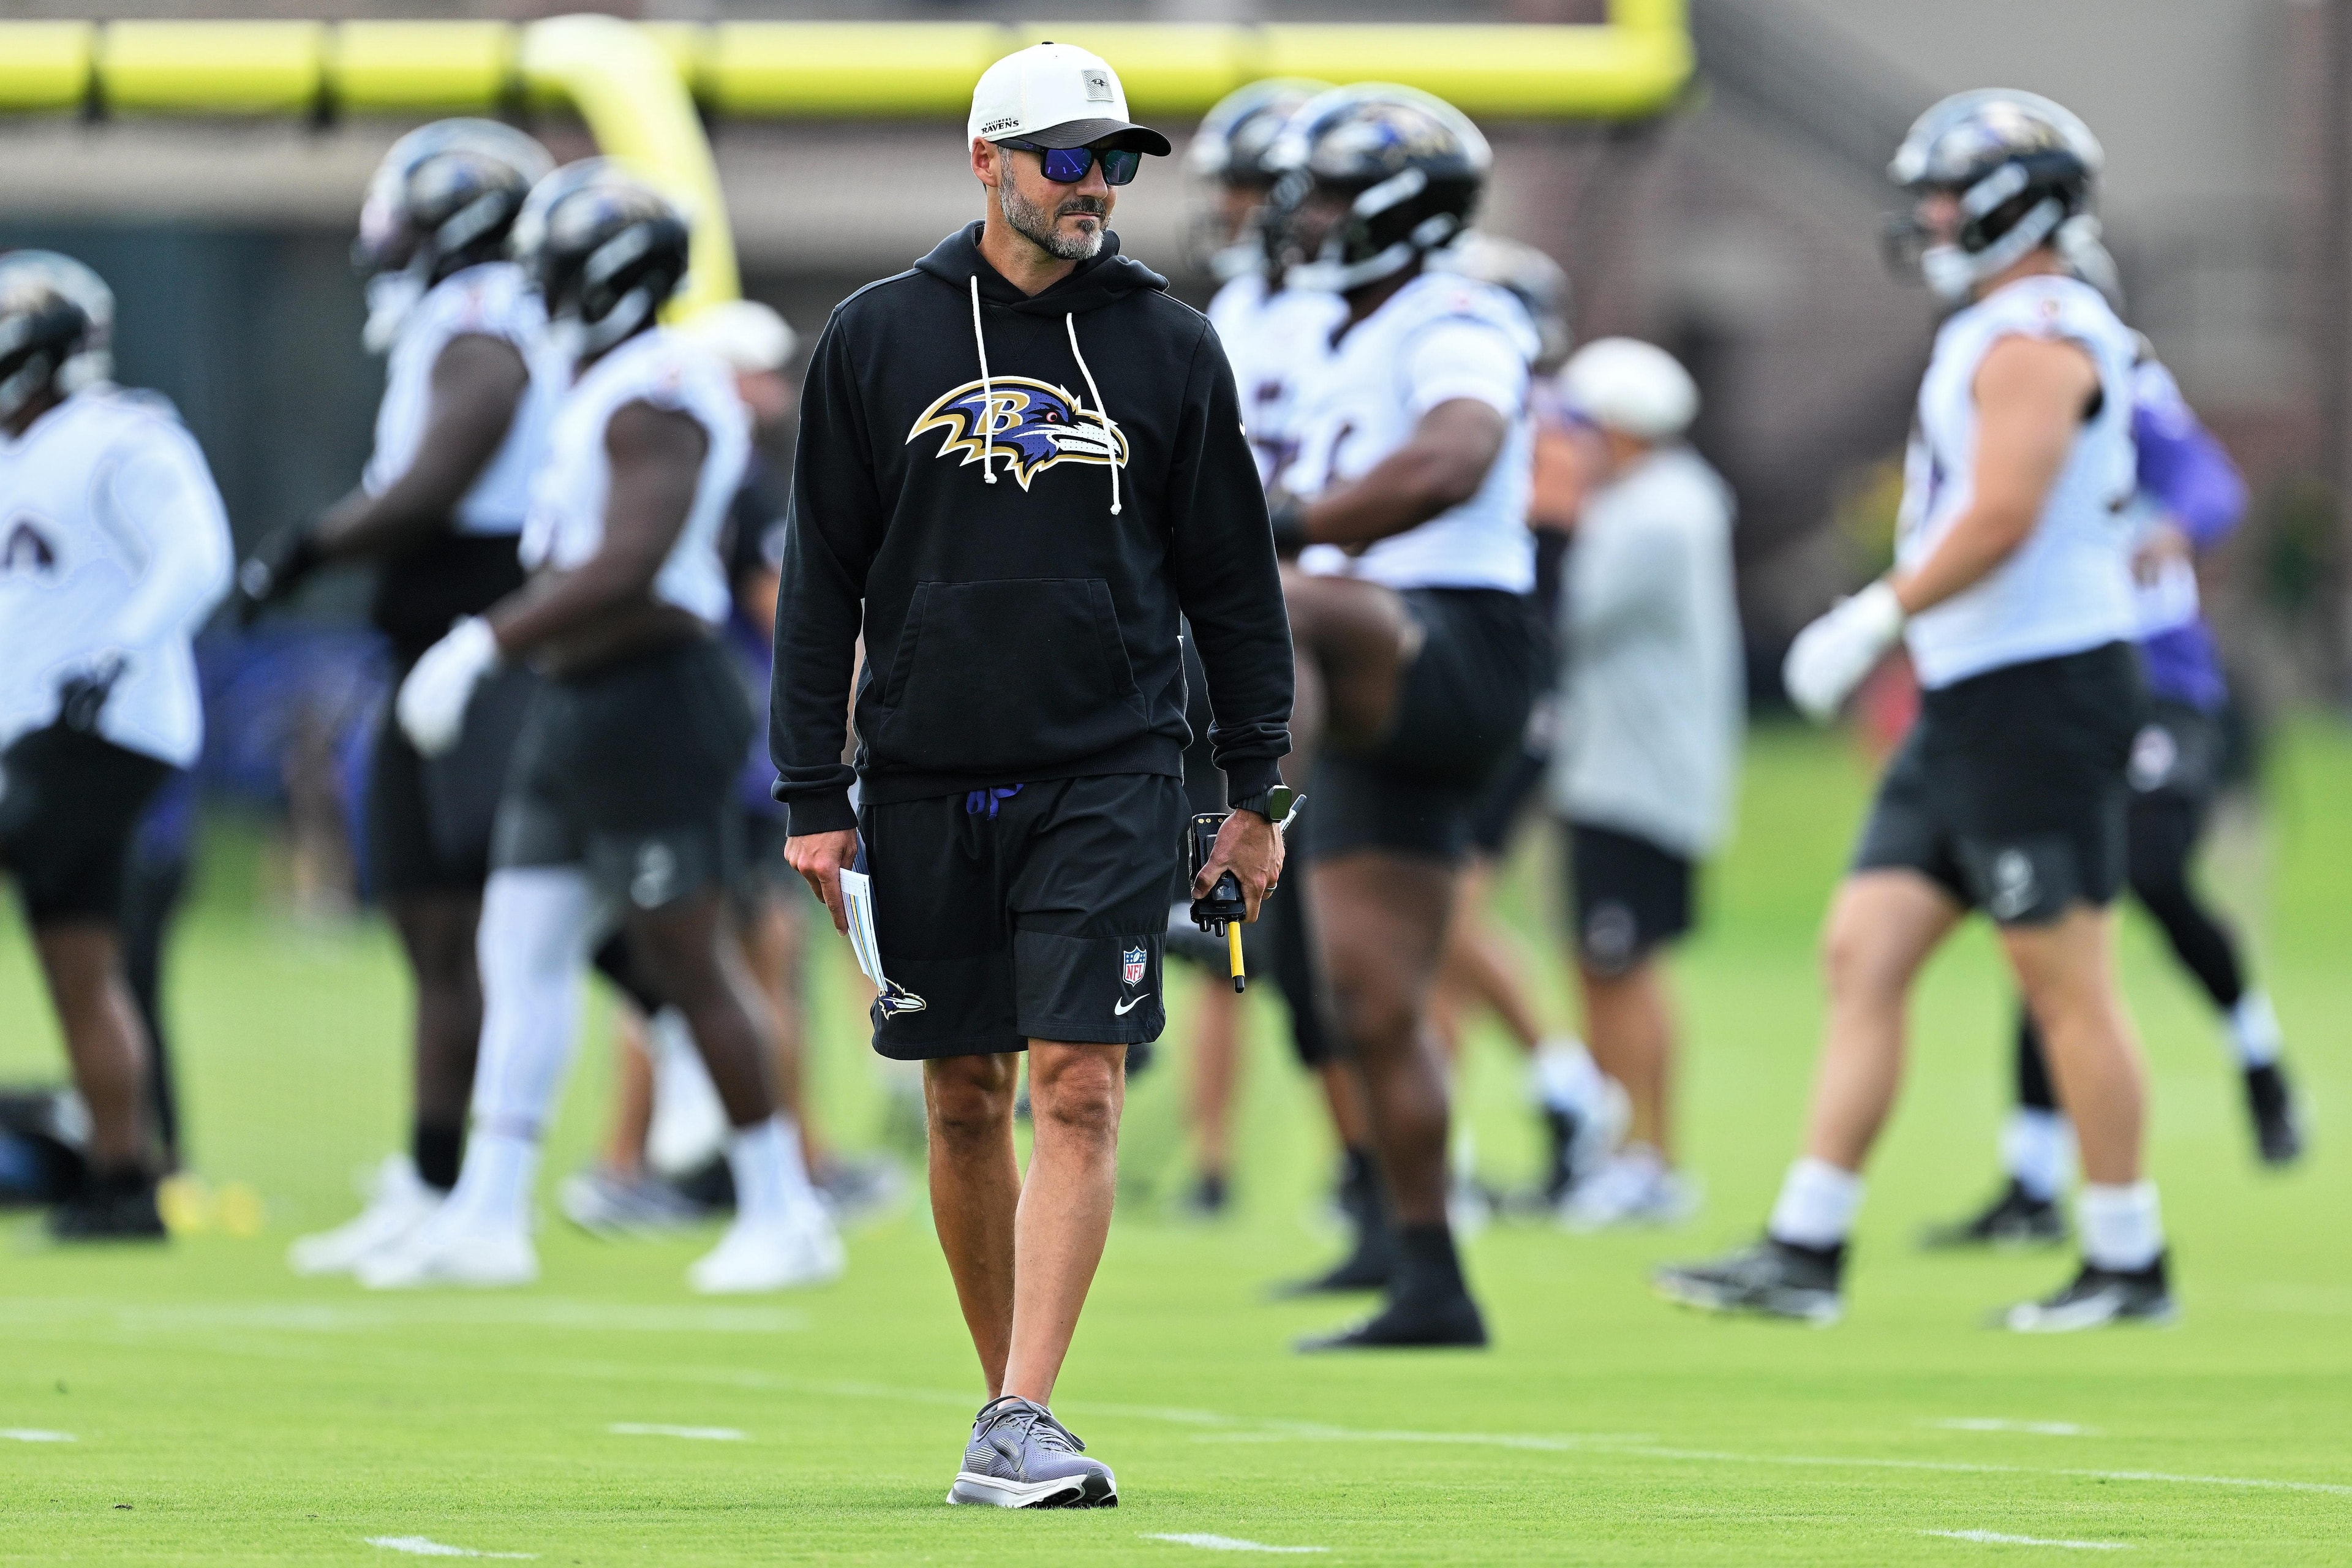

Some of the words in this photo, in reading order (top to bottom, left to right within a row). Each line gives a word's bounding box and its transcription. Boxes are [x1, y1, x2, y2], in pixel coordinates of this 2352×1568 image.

[981, 120, 1019, 135] RAVENS
[986, 118, 1011, 126] BALTIMORE
[958, 390, 1031, 436] B
[1126, 964, 1143, 981] NFL
